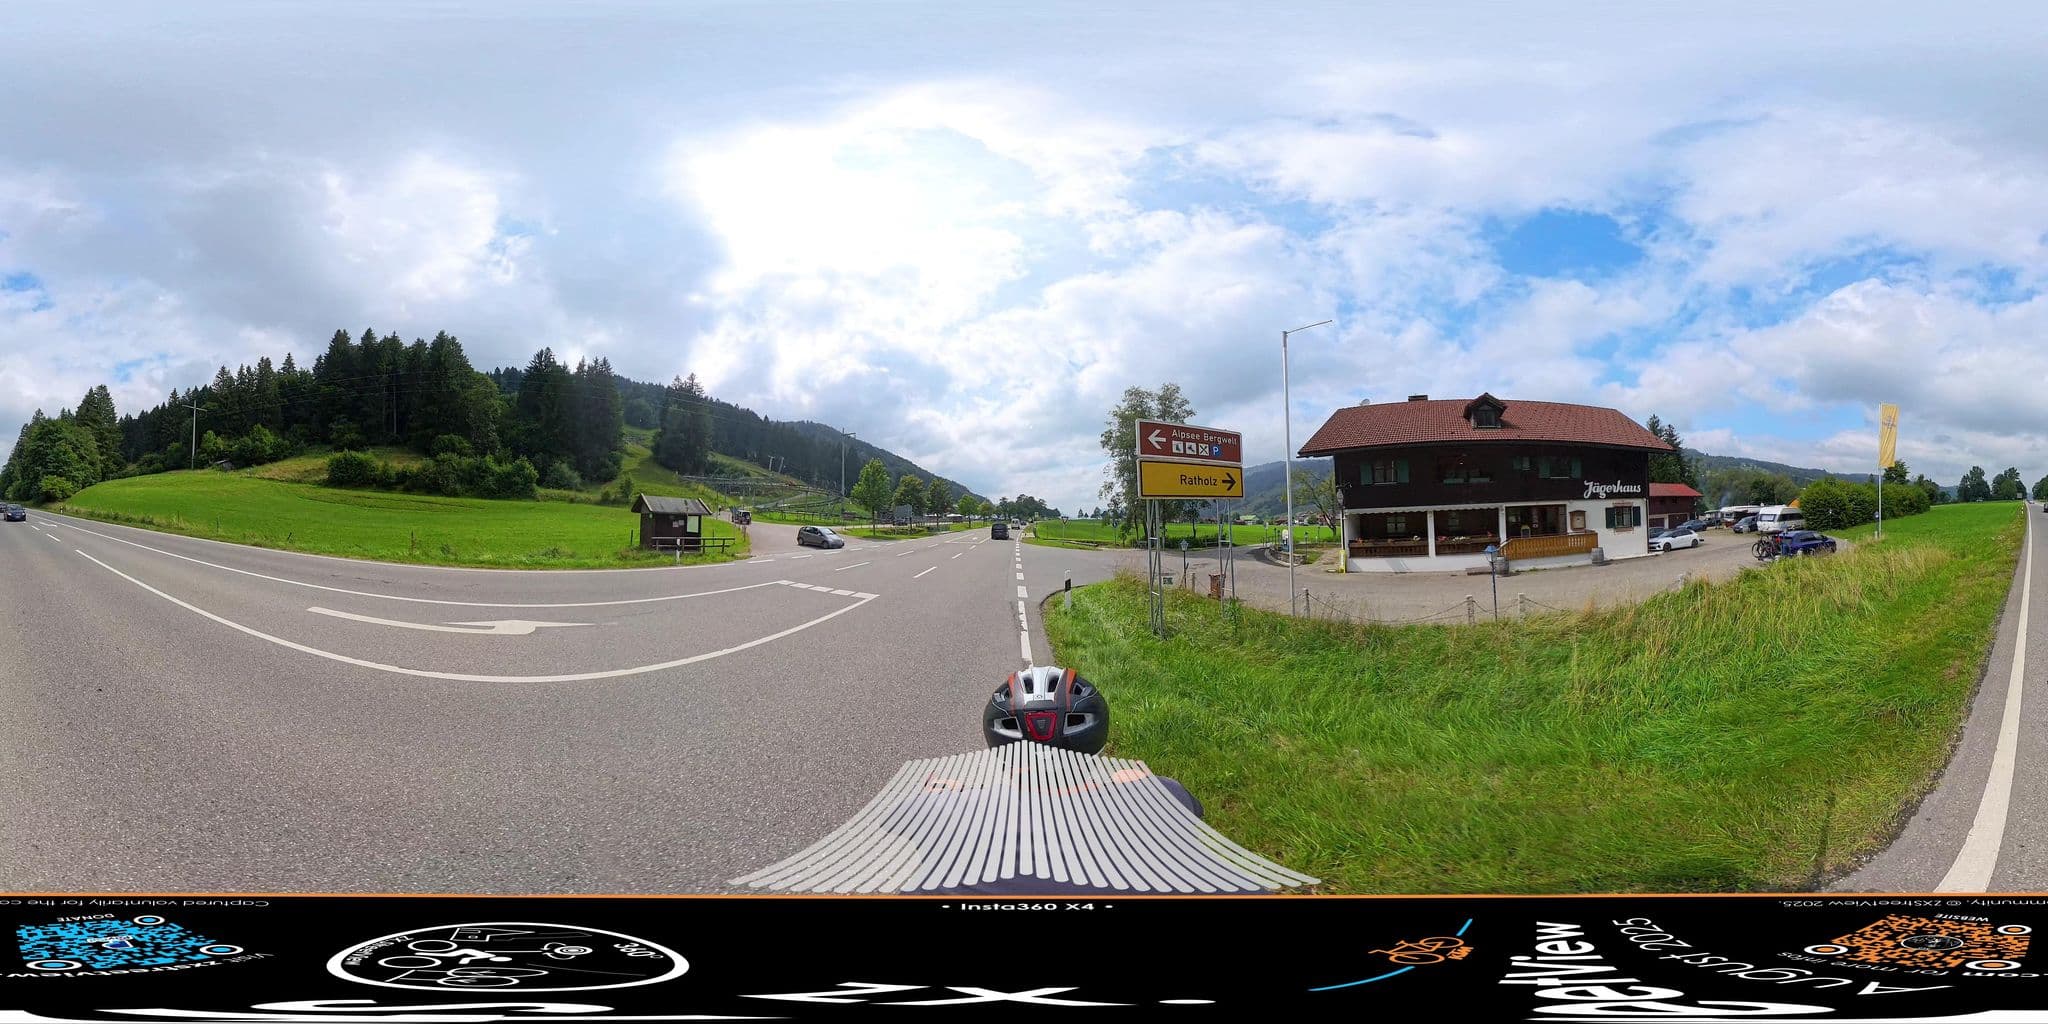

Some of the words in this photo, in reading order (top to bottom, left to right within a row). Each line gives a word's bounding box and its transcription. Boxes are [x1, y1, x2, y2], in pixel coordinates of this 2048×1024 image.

[1171, 429, 1200, 440] Alpsee
[1203, 433, 1237, 446] Bergwelt
[1180, 475, 1217, 486] Ratholz
[1583, 480, 1641, 499] Jägerhaus
